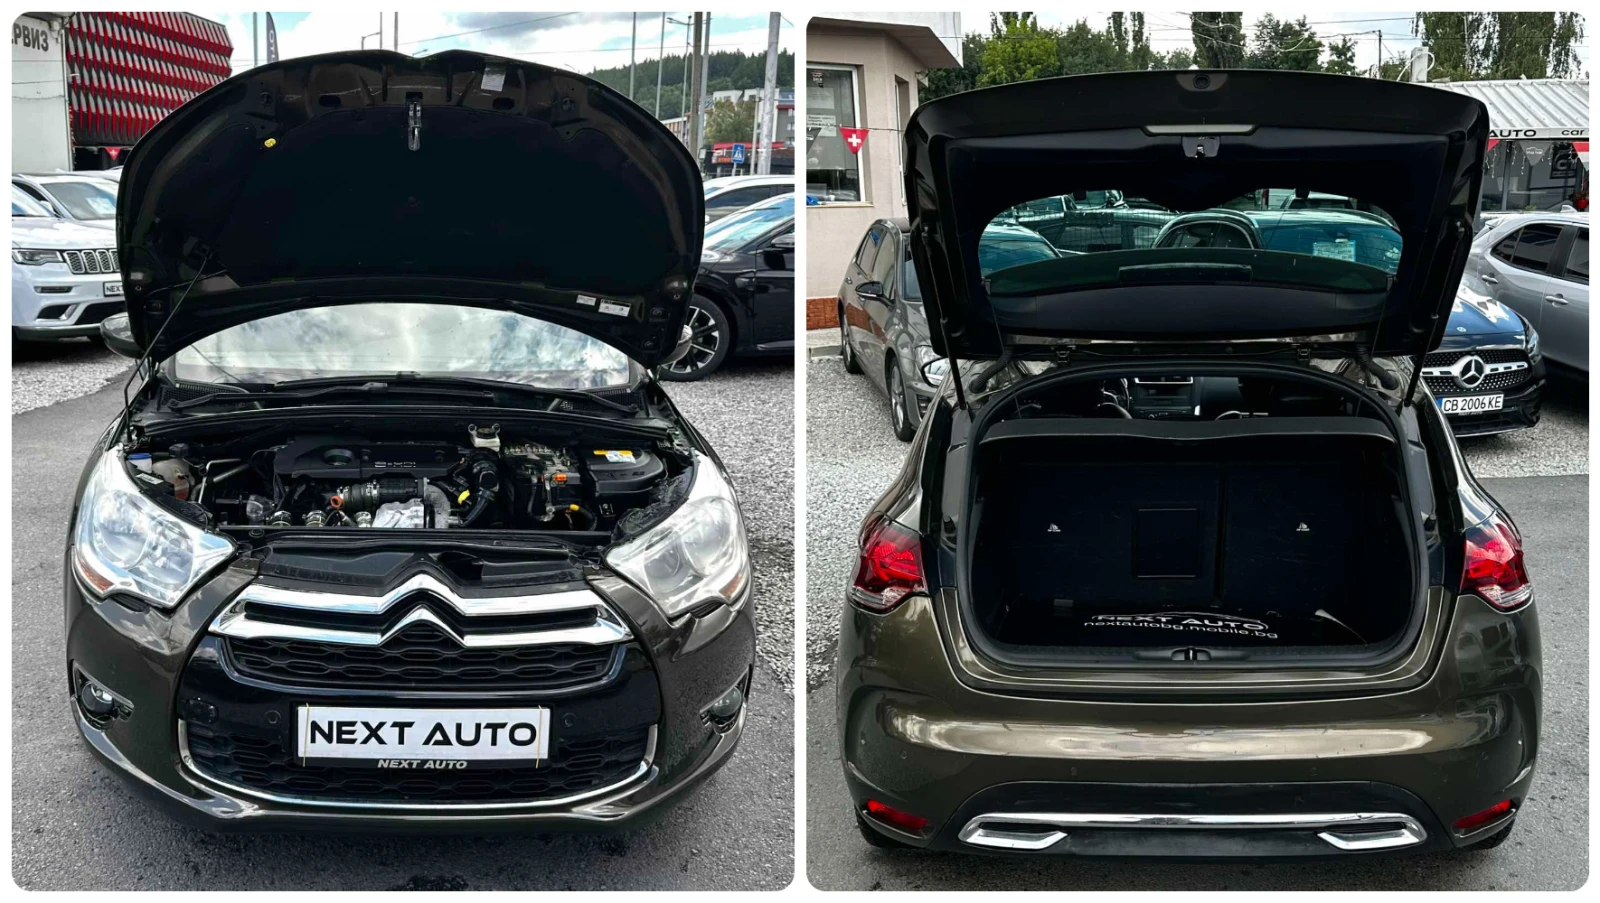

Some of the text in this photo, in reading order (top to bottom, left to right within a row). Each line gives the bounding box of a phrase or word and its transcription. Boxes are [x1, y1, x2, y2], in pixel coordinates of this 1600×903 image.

[12, 22, 49, 52] РВИЗ
[1489, 129, 1537, 138] AUTO
[1084, 621, 1278, 639] nextautobg.mobile.bg
[1181, 618, 1264, 630] AUTO
[310, 720, 537, 746] NEXT AUTO
[377, 759, 467, 770] NEXT AUTO
